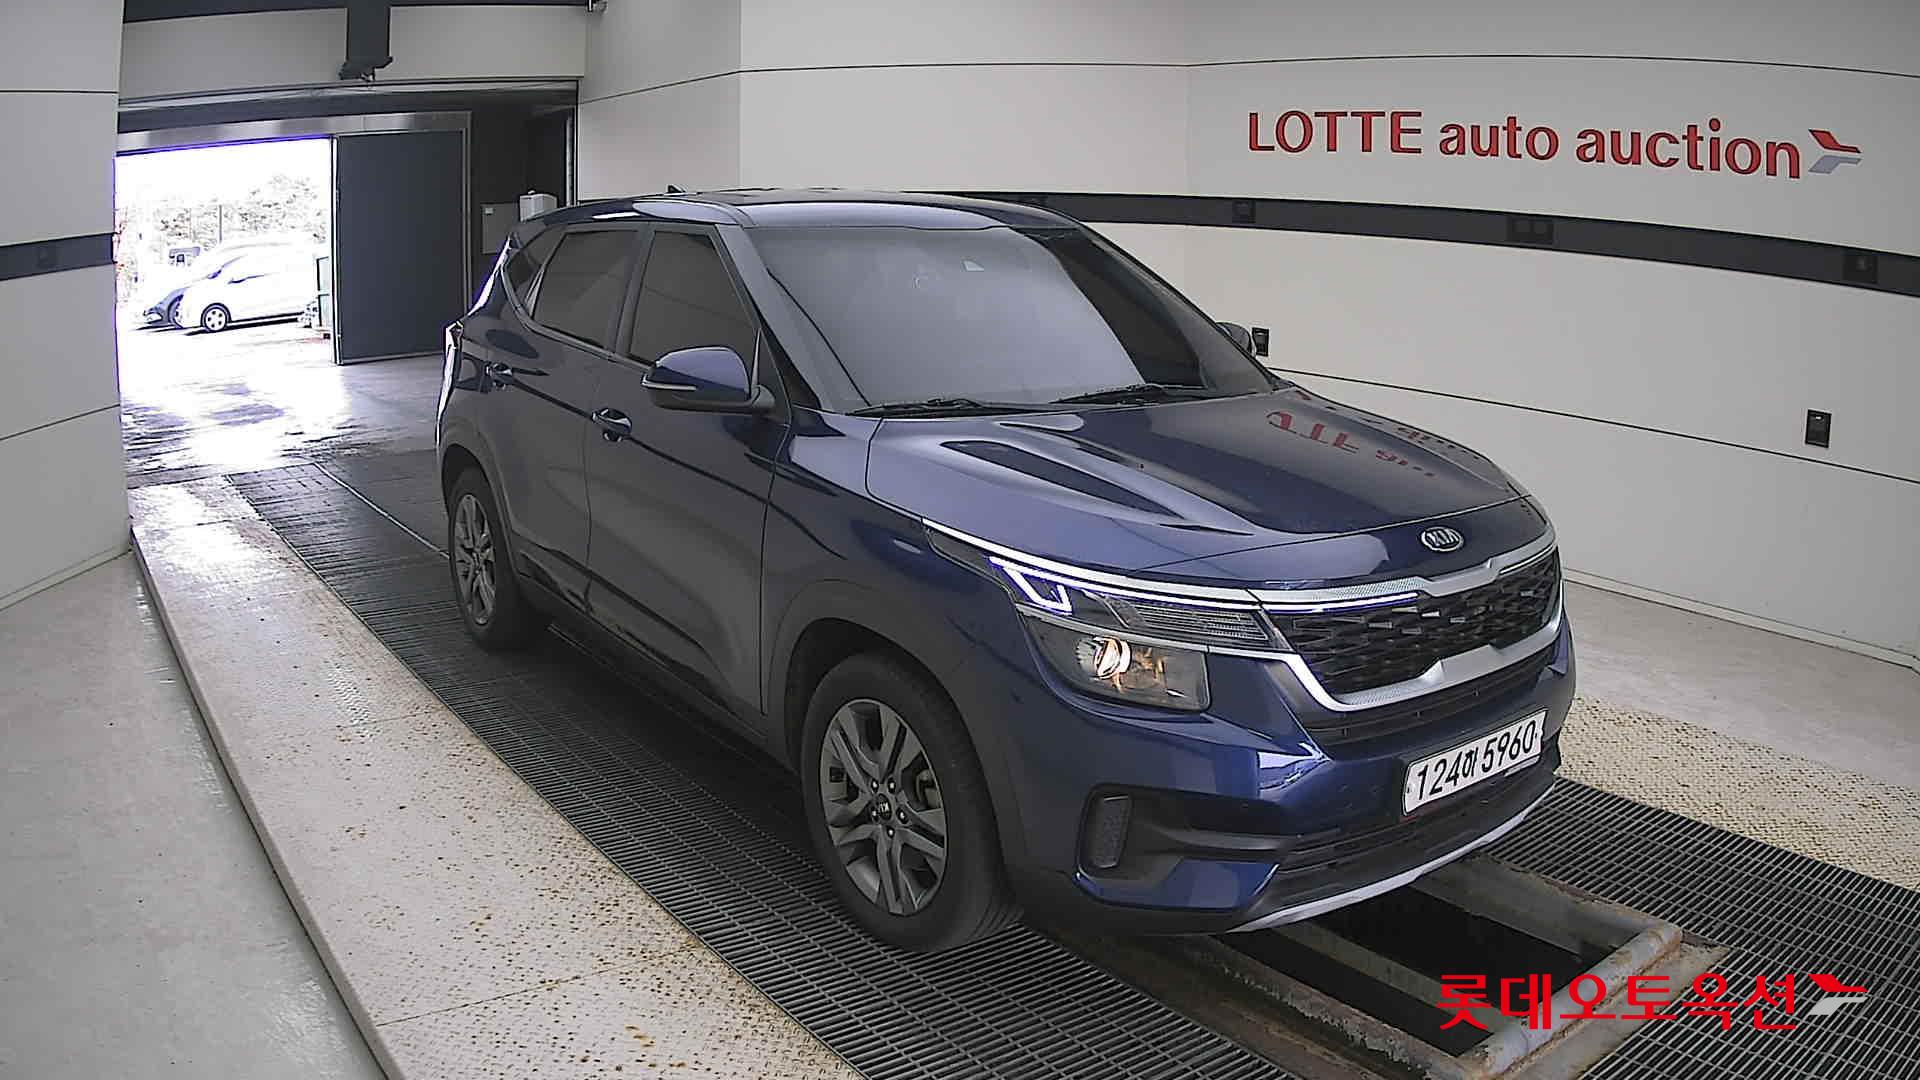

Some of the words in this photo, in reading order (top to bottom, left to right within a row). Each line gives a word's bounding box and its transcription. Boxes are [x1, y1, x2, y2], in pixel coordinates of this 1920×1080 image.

[1249, 110, 1422, 154] LOTTE
[1439, 116, 1560, 161] auto
[1575, 118, 1801, 179] auction
[1425, 529, 1460, 548] KIA
[1481, 719, 1536, 773] 5960
